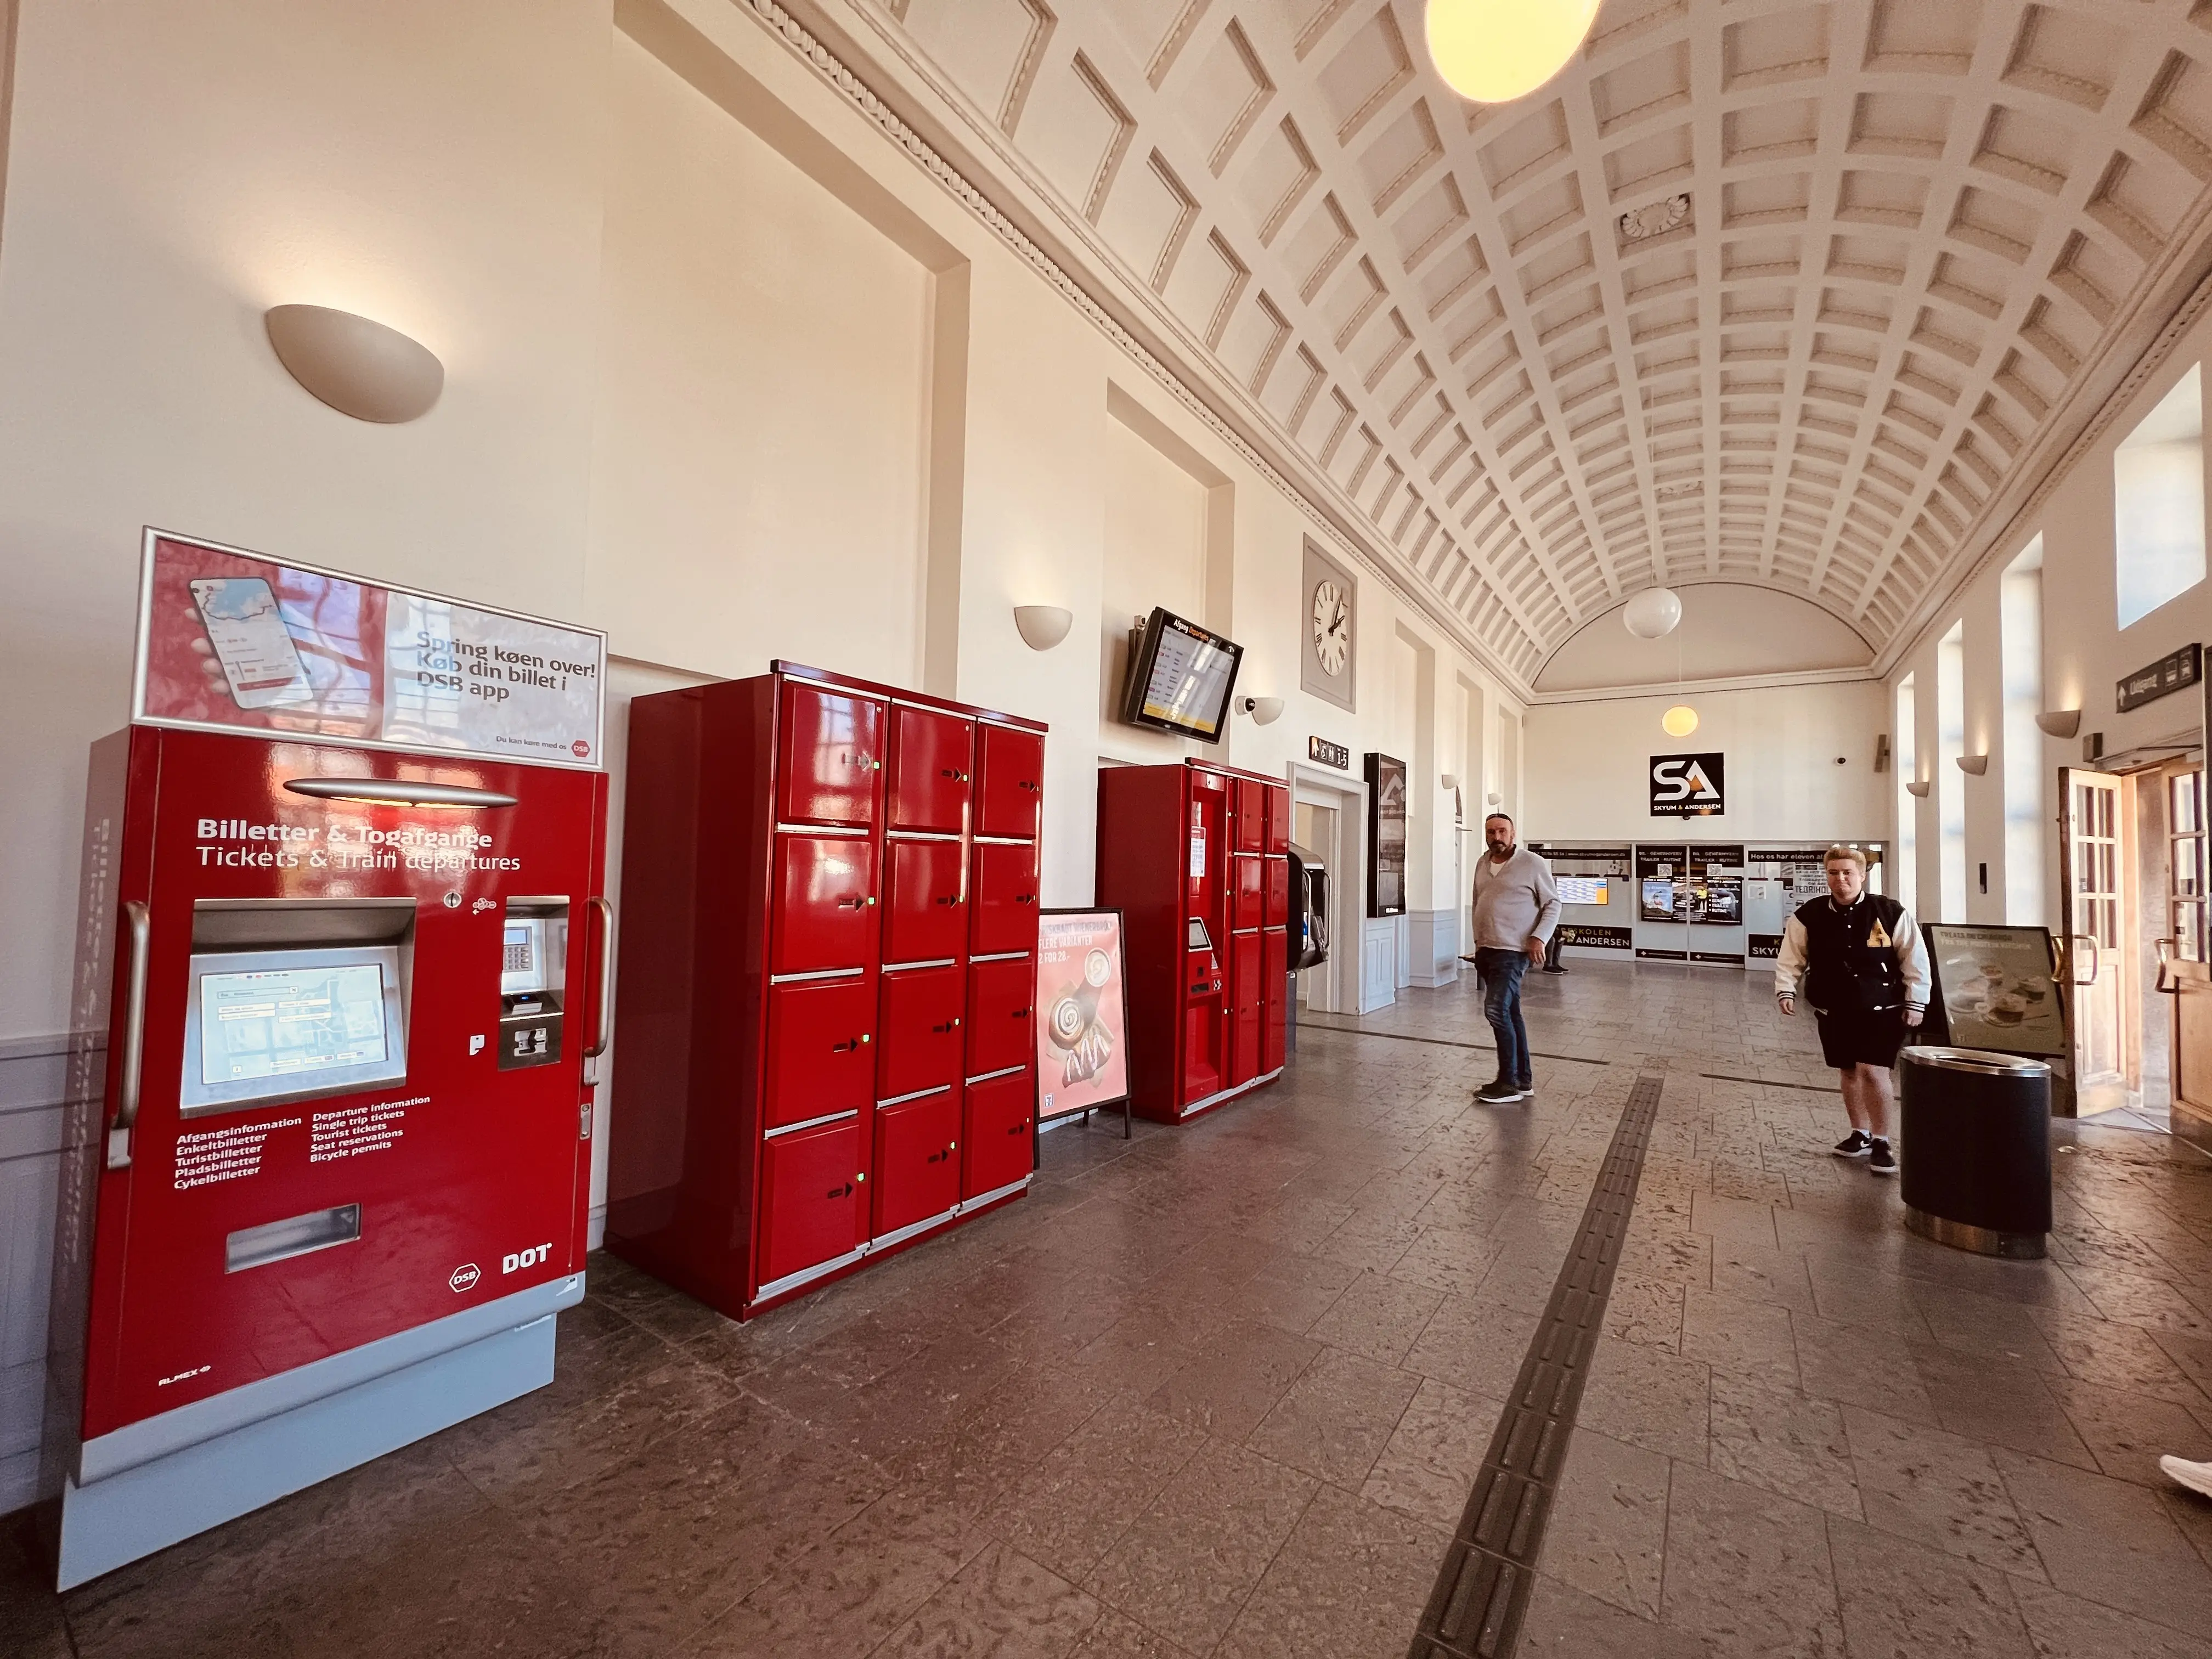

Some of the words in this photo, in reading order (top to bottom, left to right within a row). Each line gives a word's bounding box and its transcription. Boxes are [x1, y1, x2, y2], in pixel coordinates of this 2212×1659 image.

[1173, 619, 1189, 634] Afgang
[417, 631, 488, 661] Spring
[494, 646, 544, 668] køen
[550, 659, 595, 678] over!
[417, 651, 462, 672] Køb
[469, 661, 501, 679] din
[509, 666, 557, 690] billet
[561, 676, 566, 691] i
[417, 671, 463, 692] DSB
[470, 682, 510, 702] app
[509, 736, 522, 744] kan
[542, 741, 557, 749] med
[573, 744, 588, 753] DSB
[1653, 760, 1720, 801] SA
[198, 819, 319, 842] Billetter
[328, 825, 347, 843] &
[358, 826, 492, 849] Togafgange
[196, 846, 298, 867] Tickets
[309, 849, 328, 867] &
[340, 849, 397, 870] Train
[405, 851, 520, 872] departures
[1795, 885, 1831, 894] TEORIHOL
[1038, 939, 1058, 950] FLERE
[1059, 935, 1093, 947] VARIANTER
[1576, 937, 1629, 946] ANDERSEN
[1867, 917, 1892, 947] A
[1045, 951, 1057, 963] FOR
[312, 1105, 368, 1122] Departure
[370, 1096, 431, 1113] information
[312, 1118, 346, 1132] Single
[349, 1115, 368, 1128] trip
[370, 1109, 404, 1122] tickets
[177, 1116, 302, 1145] Afgangsinformation
[310, 1142, 336, 1153] Seat
[338, 1128, 404, 1147] reservations
[311, 1129, 349, 1143] Tourist
[352, 1122, 387, 1136] tickets
[175, 1143, 263, 1167] Turistbilletter
[176, 1132, 267, 1156] Enkeltbilletter
[309, 1149, 349, 1163] Bicycle
[352, 1140, 392, 1157] permits
[173, 1165, 261, 1190] Cykelbilletter
[174, 1154, 262, 1179] Pladsbilletter
[503, 1243, 552, 1274] DOT
[454, 1271, 477, 1285] DSB
